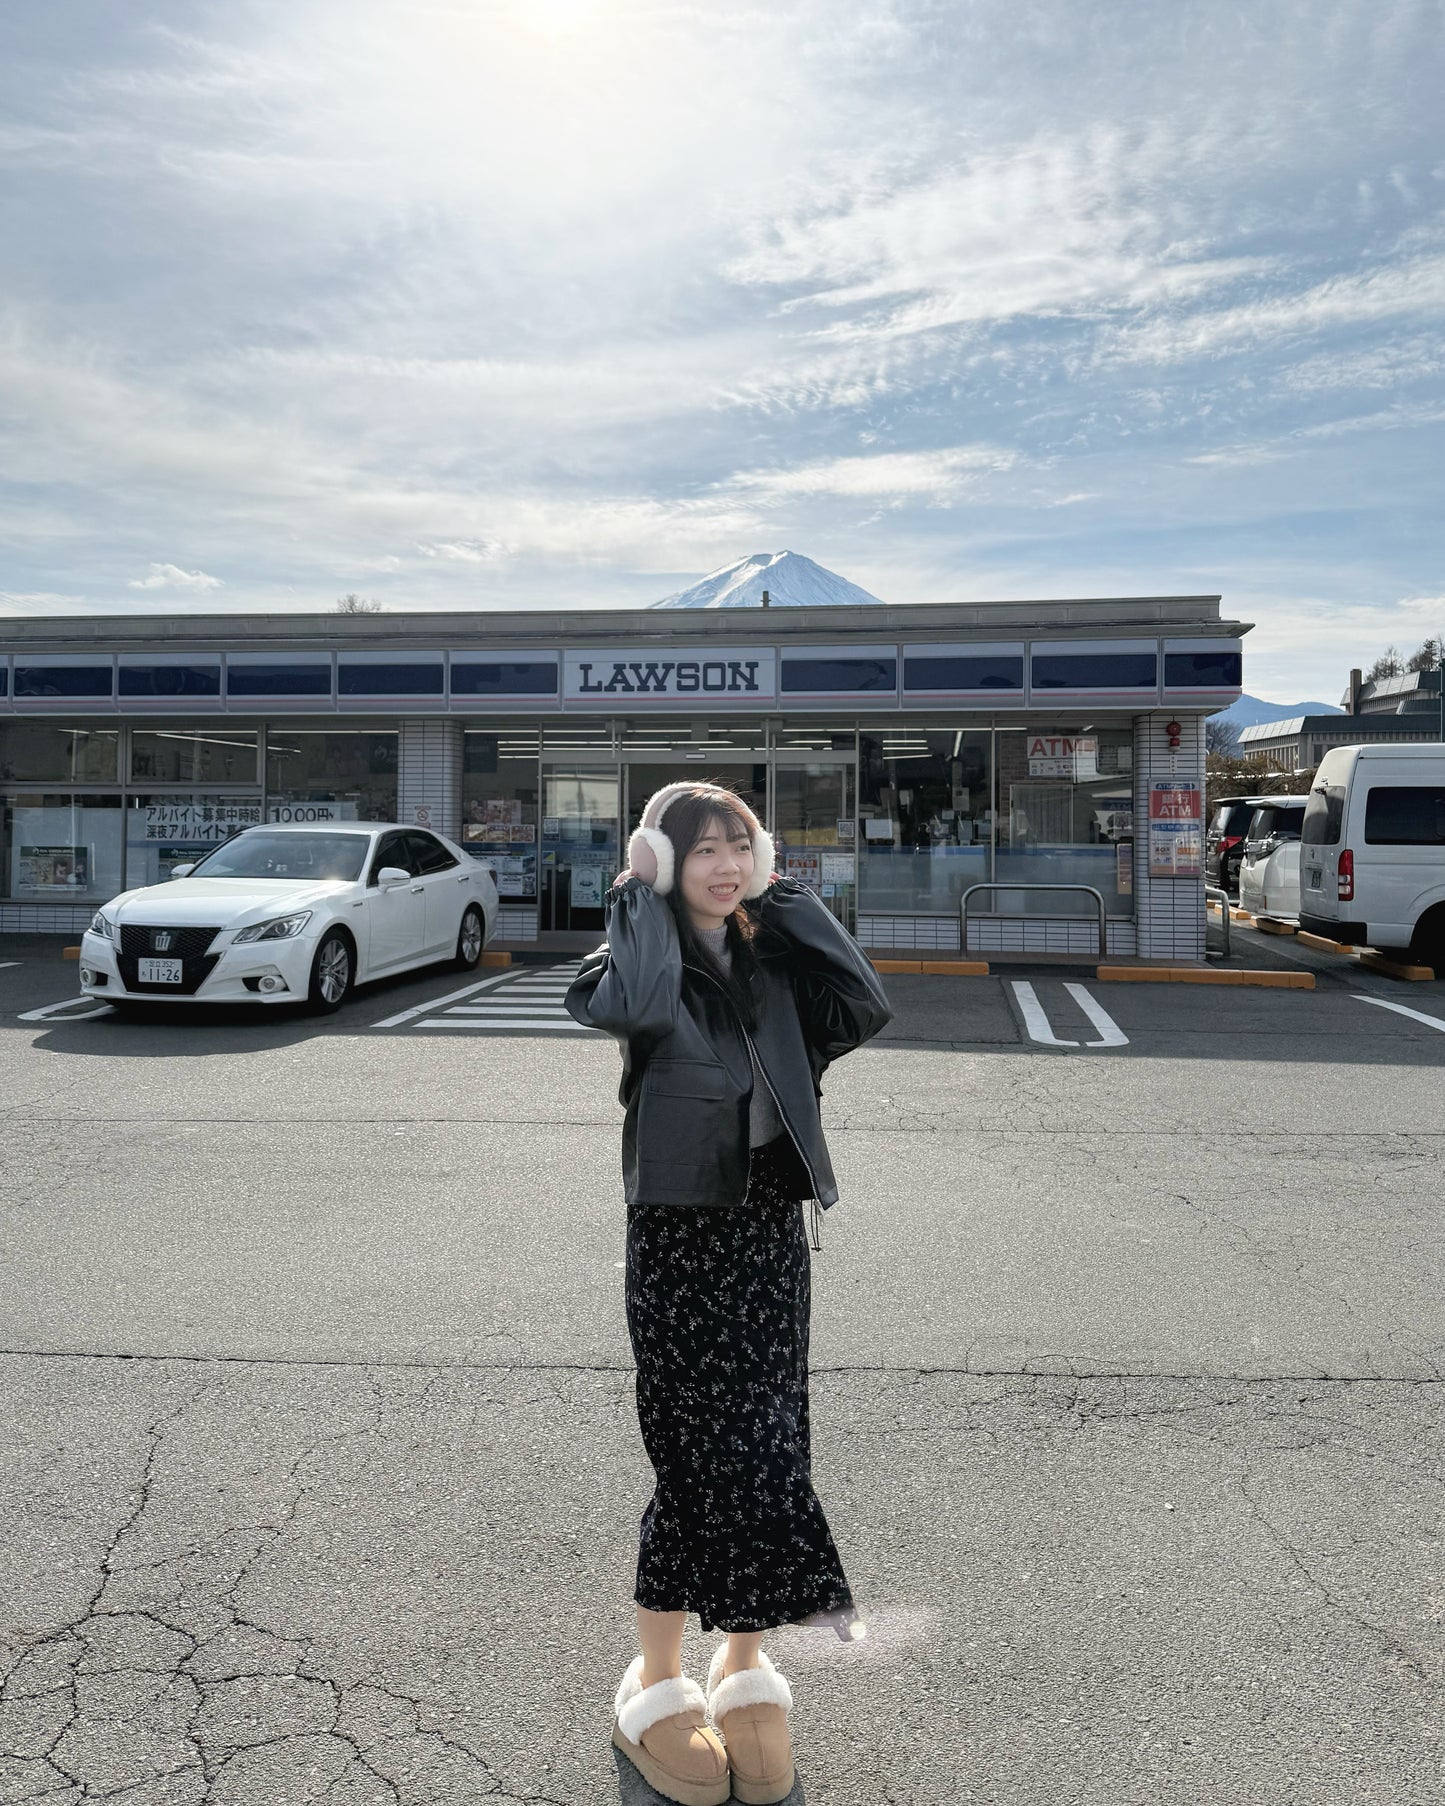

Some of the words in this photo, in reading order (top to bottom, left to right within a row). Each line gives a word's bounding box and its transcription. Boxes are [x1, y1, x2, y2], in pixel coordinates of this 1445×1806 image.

[579, 661, 759, 692] LAWSON
[1029, 738, 1083, 757] ATM
[146, 807, 261, 822] アルバイト募集中時給
[1159, 805, 1191, 816] ATM
[150, 968, 180, 981] 11-26
